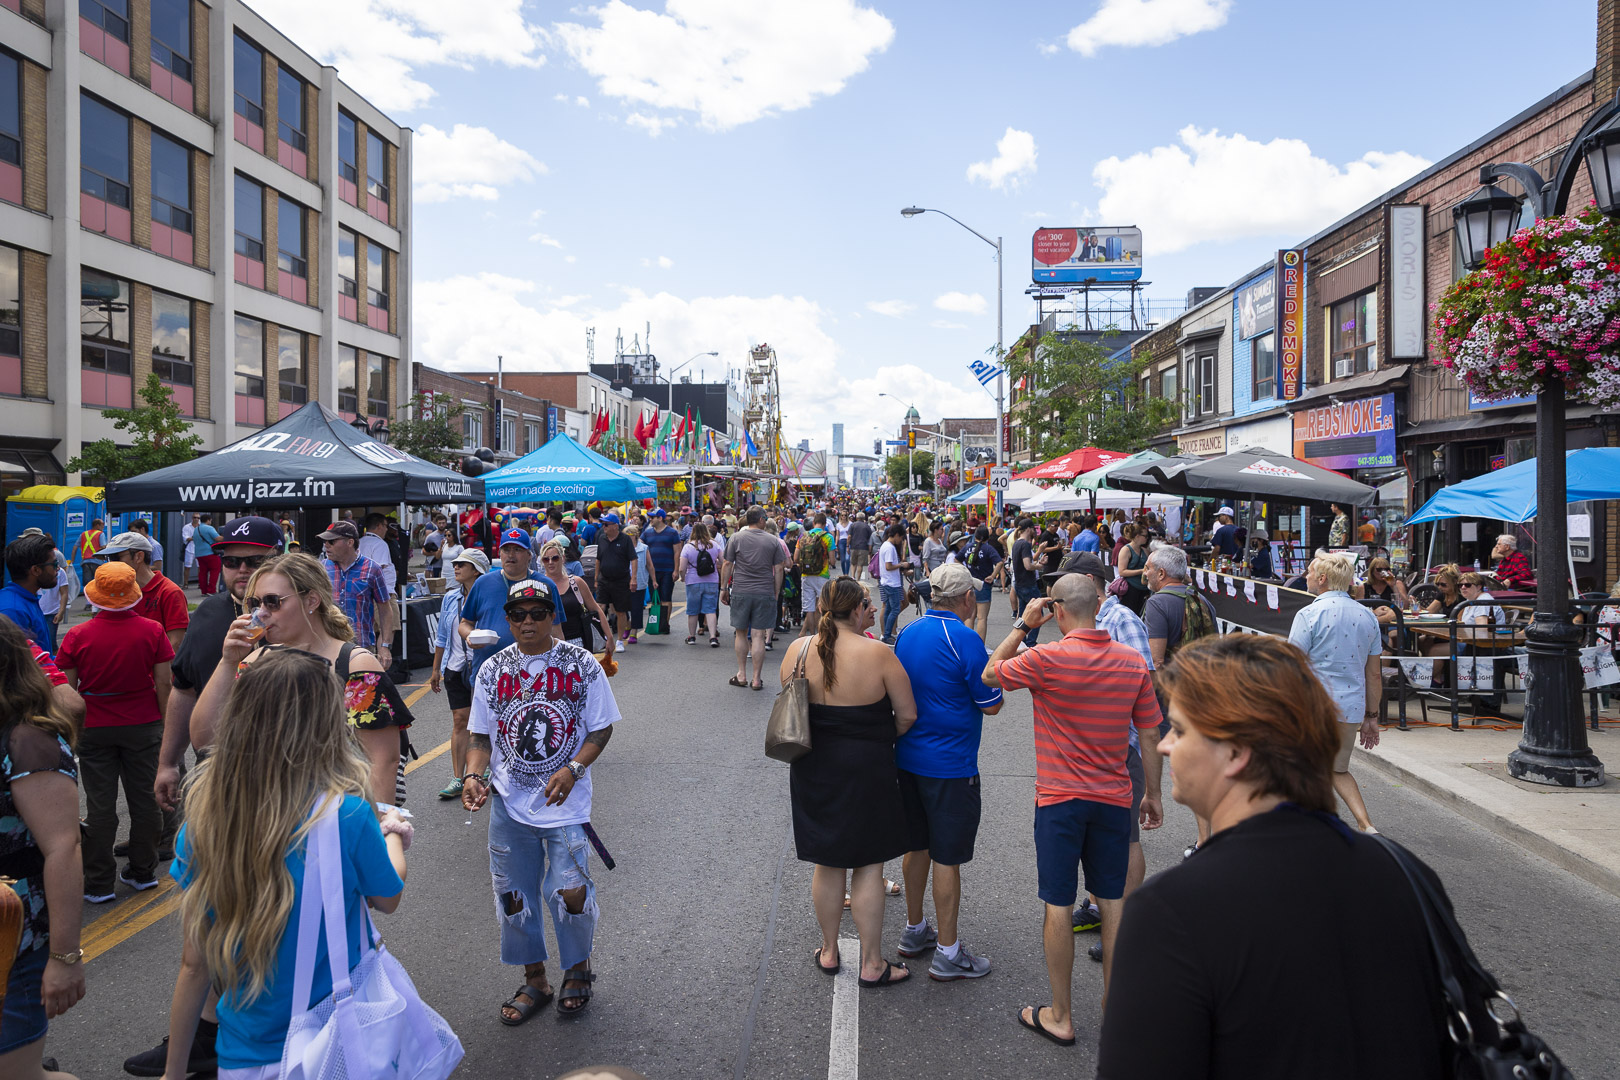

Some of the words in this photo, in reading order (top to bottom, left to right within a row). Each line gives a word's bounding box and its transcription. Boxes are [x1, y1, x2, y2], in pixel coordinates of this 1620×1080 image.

[1284, 268, 1298, 314] RED
[1282, 319, 1297, 397] SMOKE
[1180, 440, 1198, 454] DOUCE
[1199, 436, 1222, 452] FRANCE
[1358, 455, 1393, 466] 647-351-2332
[1492, 458, 1506, 470] OPE
[500, 465, 591, 476] sodastream
[1248, 464, 1299, 474] Coors
[178, 476, 335, 504] www.jazz.fm
[427, 478, 472, 500] www.jazz.fm
[992, 478, 1008, 488] 40
[489, 486, 519, 496] water
[520, 484, 552, 496] made
[553, 484, 596, 497] exciting
[232, 521, 250, 536] A
